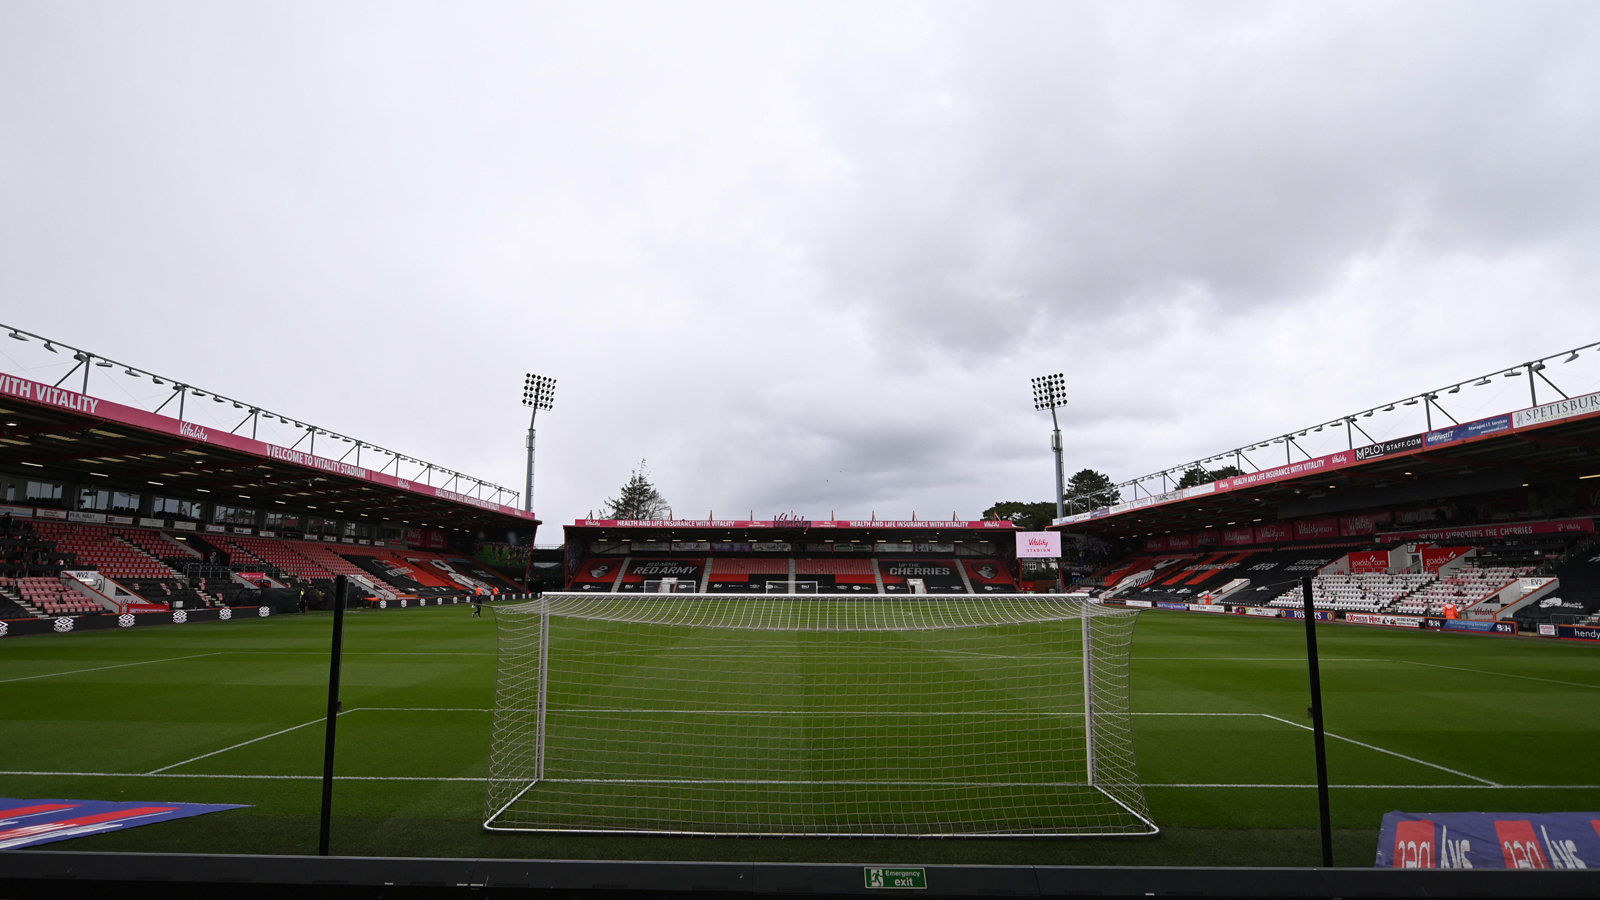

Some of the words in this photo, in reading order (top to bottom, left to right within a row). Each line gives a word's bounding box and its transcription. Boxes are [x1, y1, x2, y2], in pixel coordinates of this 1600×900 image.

[36, 384, 99, 414] VITALITY
[1525, 393, 1600, 421] SPETISBUR
[1468, 423, 1486, 431] Managed
[1491, 418, 1508, 426] Services
[179, 421, 208, 442] Vitality
[1386, 438, 1422, 451] STAFF.COM
[266, 444, 304, 464] WELCOME
[304, 453, 313, 466] TO
[314, 456, 341, 473] VITALITY
[340, 462, 366, 479] STADIUM
[1331, 454, 1347, 464] Vitality
[1219, 481, 1229, 489] Vitality
[1232, 476, 1248, 486] HEALTH
[1247, 475, 1257, 483] AND
[1256, 473, 1265, 481] LIFE
[1265, 468, 1291, 479] INSURANCE
[1290, 465, 1303, 474] WITH
[1303, 459, 1325, 471] VITALITY
[774, 512, 810, 531] Vitality
[984, 520, 1000, 528] Vitality
[1348, 516, 1373, 531] Vitality
[1260, 526, 1279, 540] Vitality
[1298, 522, 1319, 538] Vitality
[1485, 528, 1497, 536] THE
[1500, 526, 1533, 536] CHERRIES
[916, 544, 922, 552] C
[928, 544, 933, 552] D
[1028, 537, 1049, 548] Vitality
[632, 566, 660, 575] RED
[658, 566, 697, 574] ARMY
[889, 567, 950, 575] CHERRIES
[1574, 628, 1600, 640] hendy
[894, 877, 914, 886] exit
